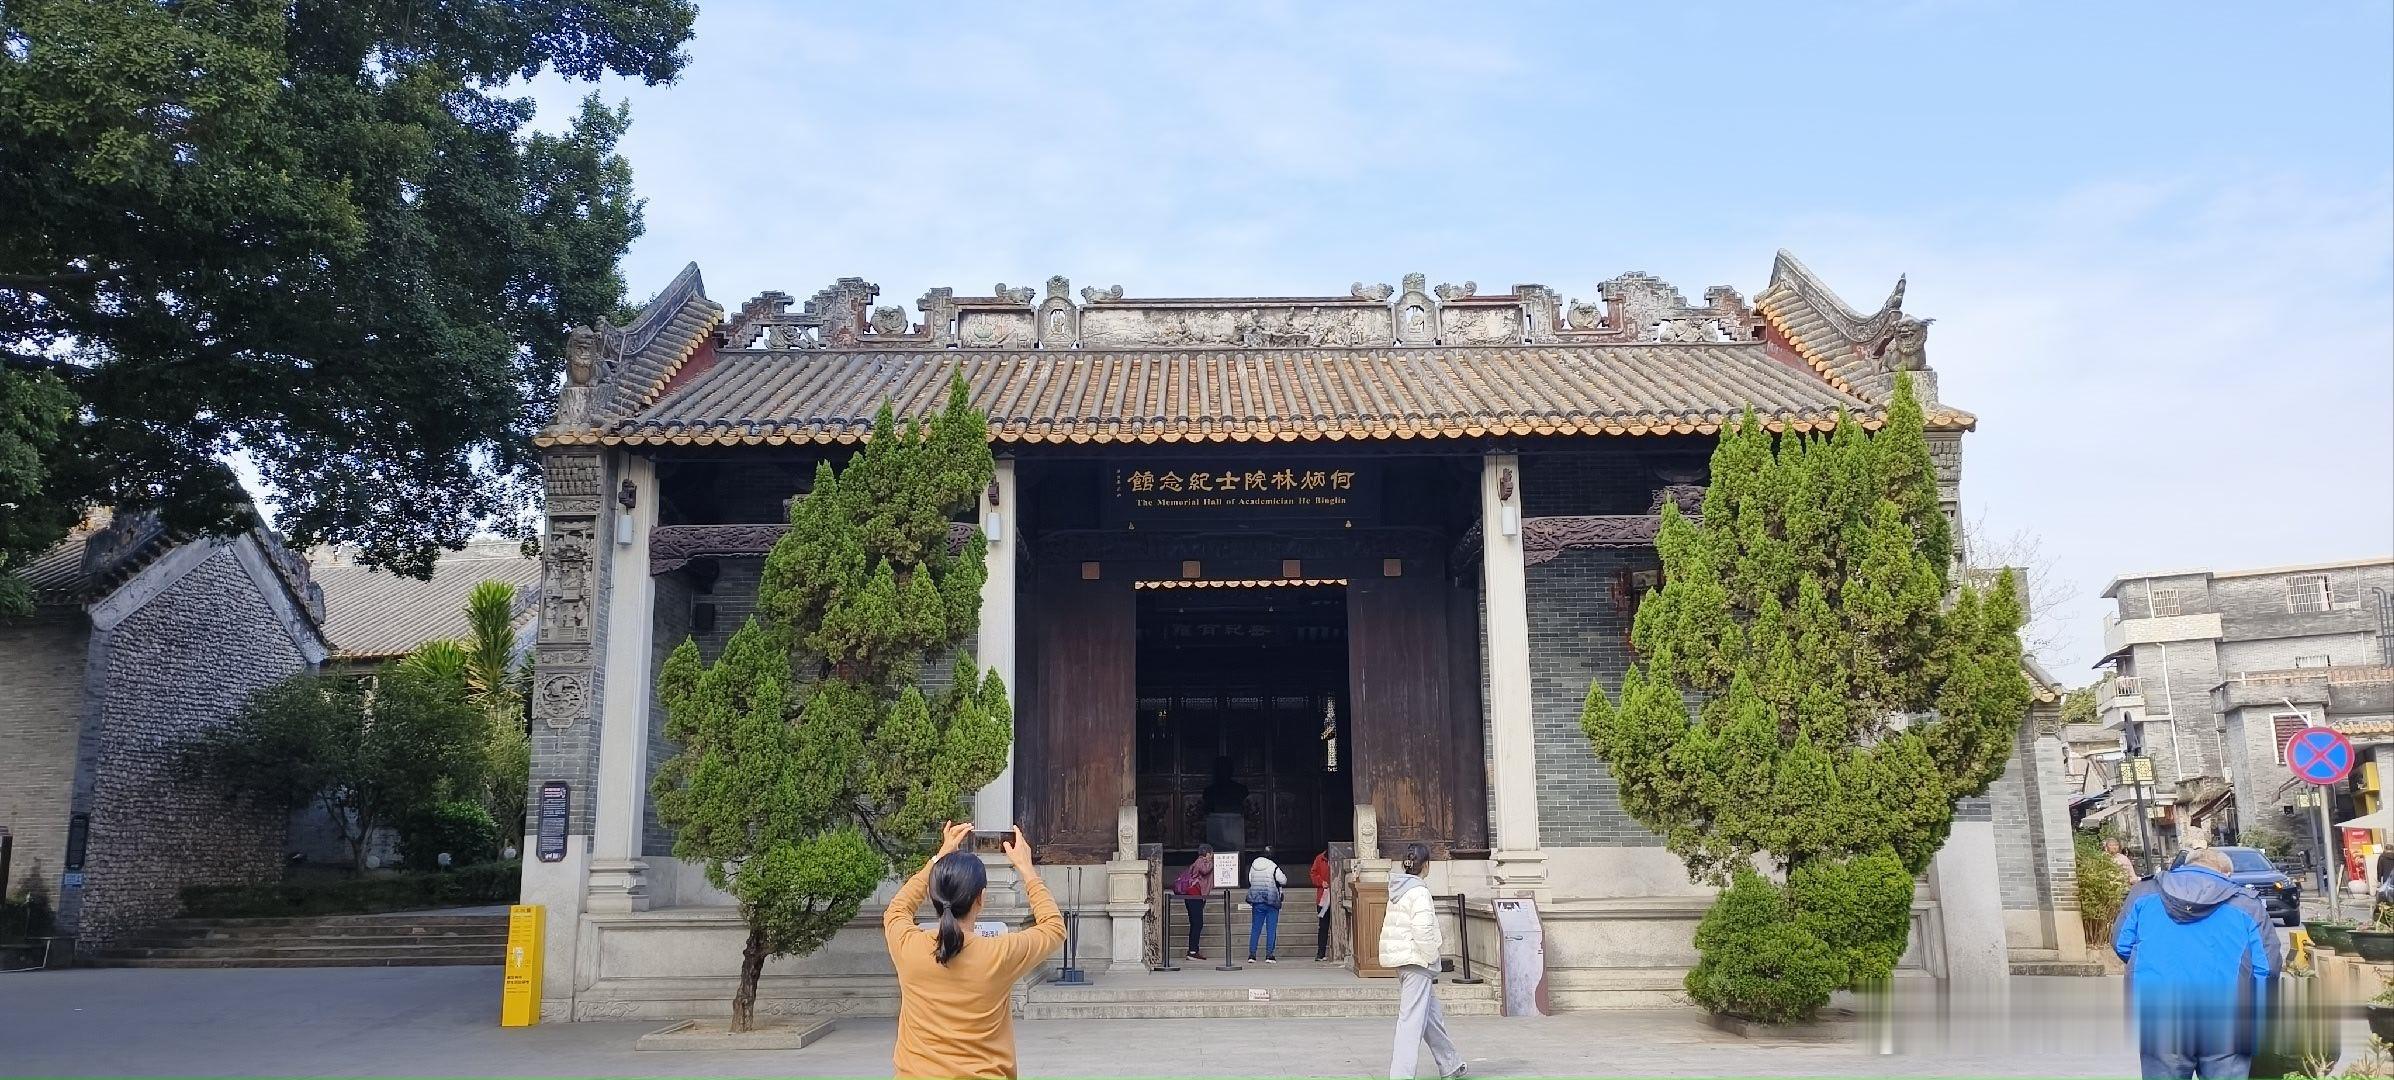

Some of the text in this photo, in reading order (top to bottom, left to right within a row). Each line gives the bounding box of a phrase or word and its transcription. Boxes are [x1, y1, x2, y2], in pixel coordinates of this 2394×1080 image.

[1136, 498, 1153, 506] The
[1157, 498, 1200, 506] Memorial
[1203, 498, 1222, 506] Hall
[1239, 497, 1294, 505] Academician
[1299, 496, 1311, 505] He
[1315, 496, 1346, 505] Binglin
